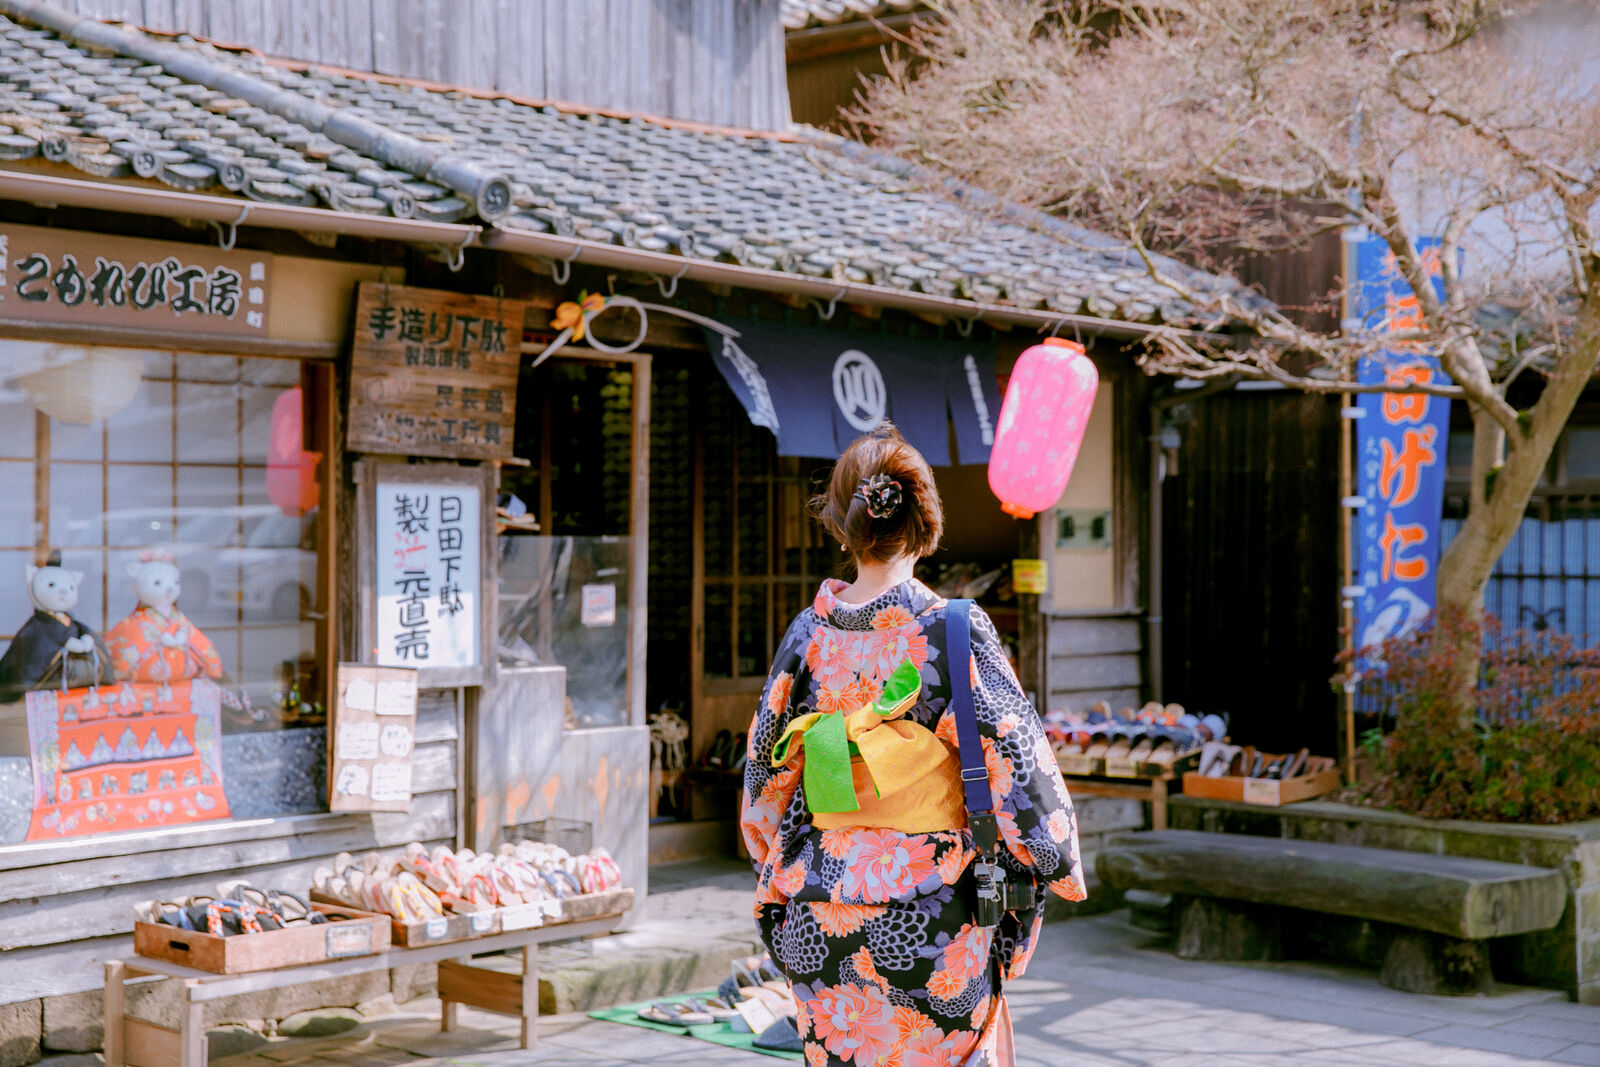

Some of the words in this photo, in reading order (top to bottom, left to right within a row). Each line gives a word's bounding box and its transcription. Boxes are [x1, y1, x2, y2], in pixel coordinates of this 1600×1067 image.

[13, 252, 244, 320] こもれび工房
[368, 305, 508, 353] 手造り下駄
[438, 495, 465, 618] 日田下駄
